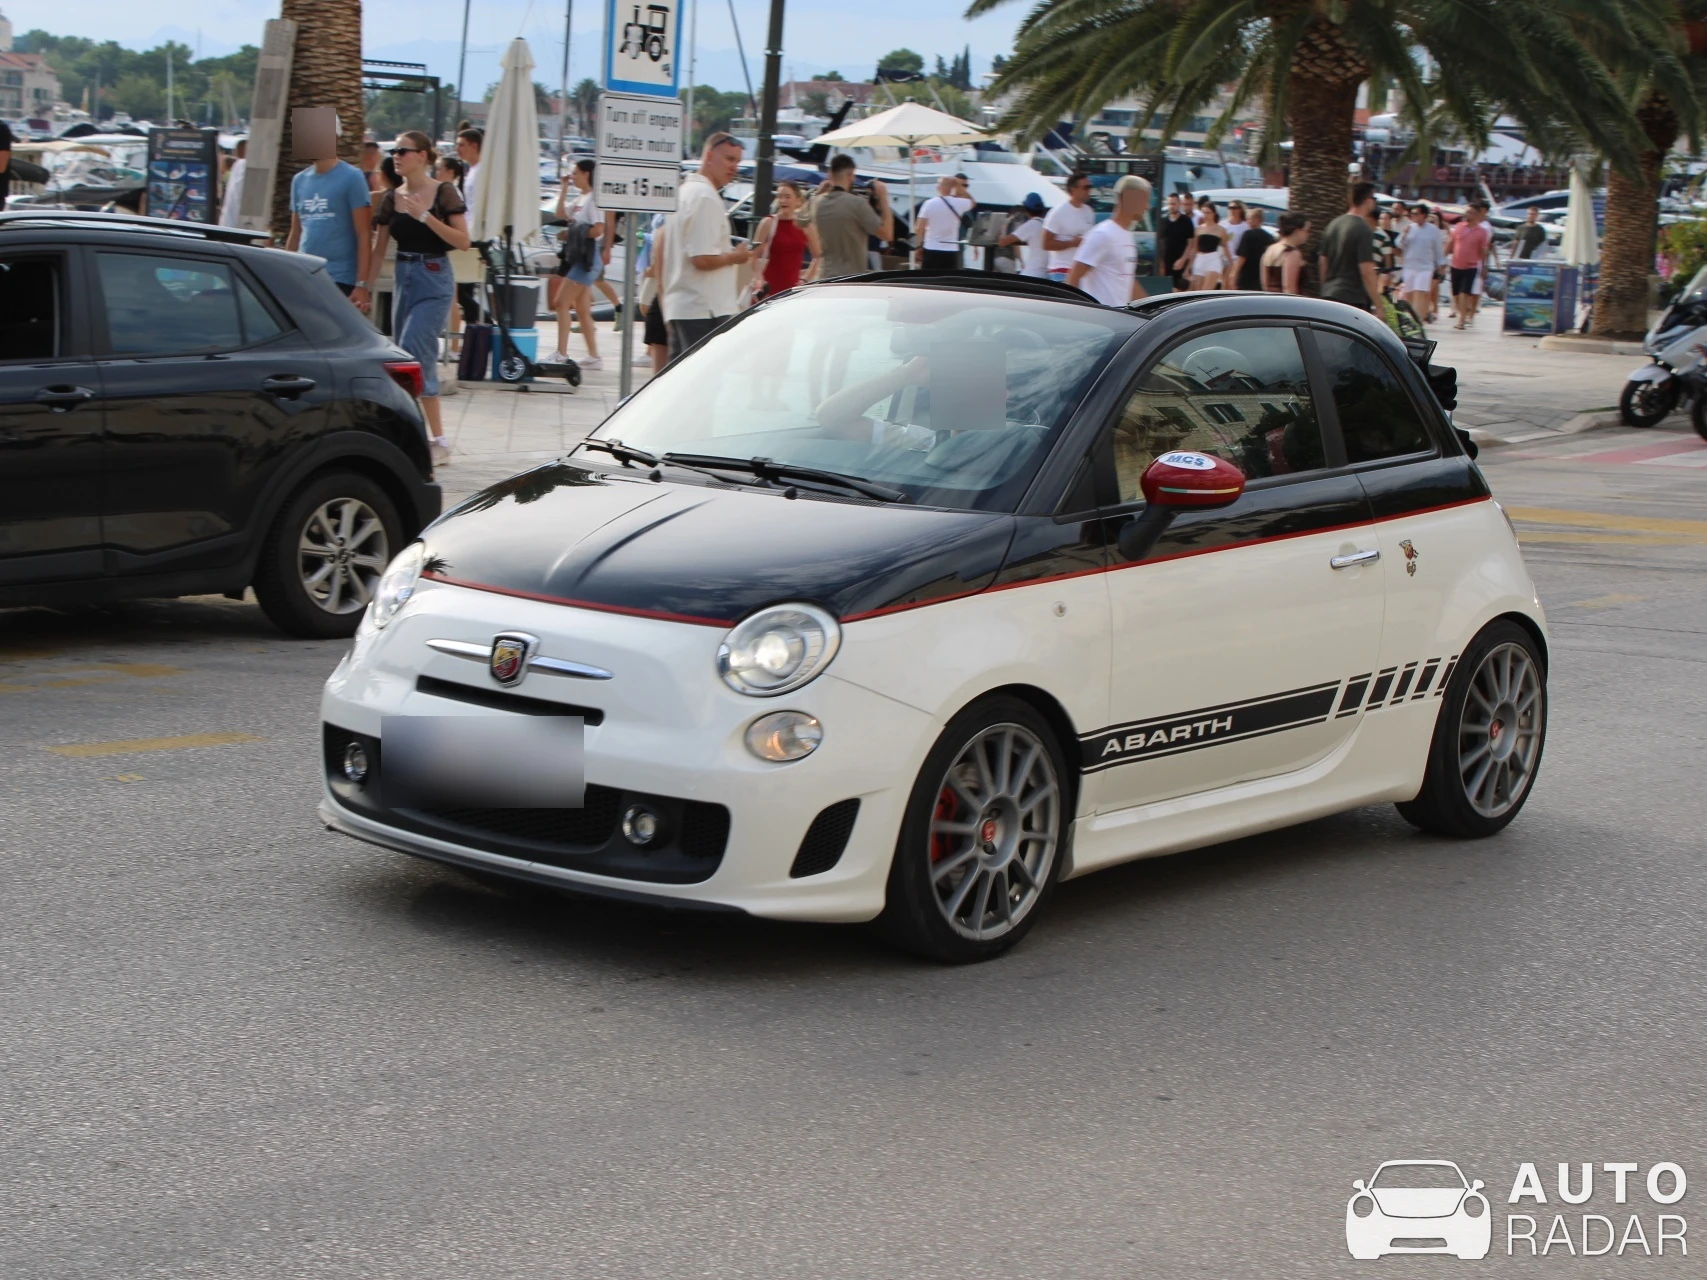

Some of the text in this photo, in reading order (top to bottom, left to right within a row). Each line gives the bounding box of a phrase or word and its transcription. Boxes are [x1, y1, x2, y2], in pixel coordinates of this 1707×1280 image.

[606, 106, 628, 123] Turn
[649, 112, 679, 131] engine
[606, 132, 643, 152] Ugasite
[601, 178, 675, 198] max 15 min
[1167, 455, 1204, 466] MCS
[1101, 715, 1233, 757] ABARTH
